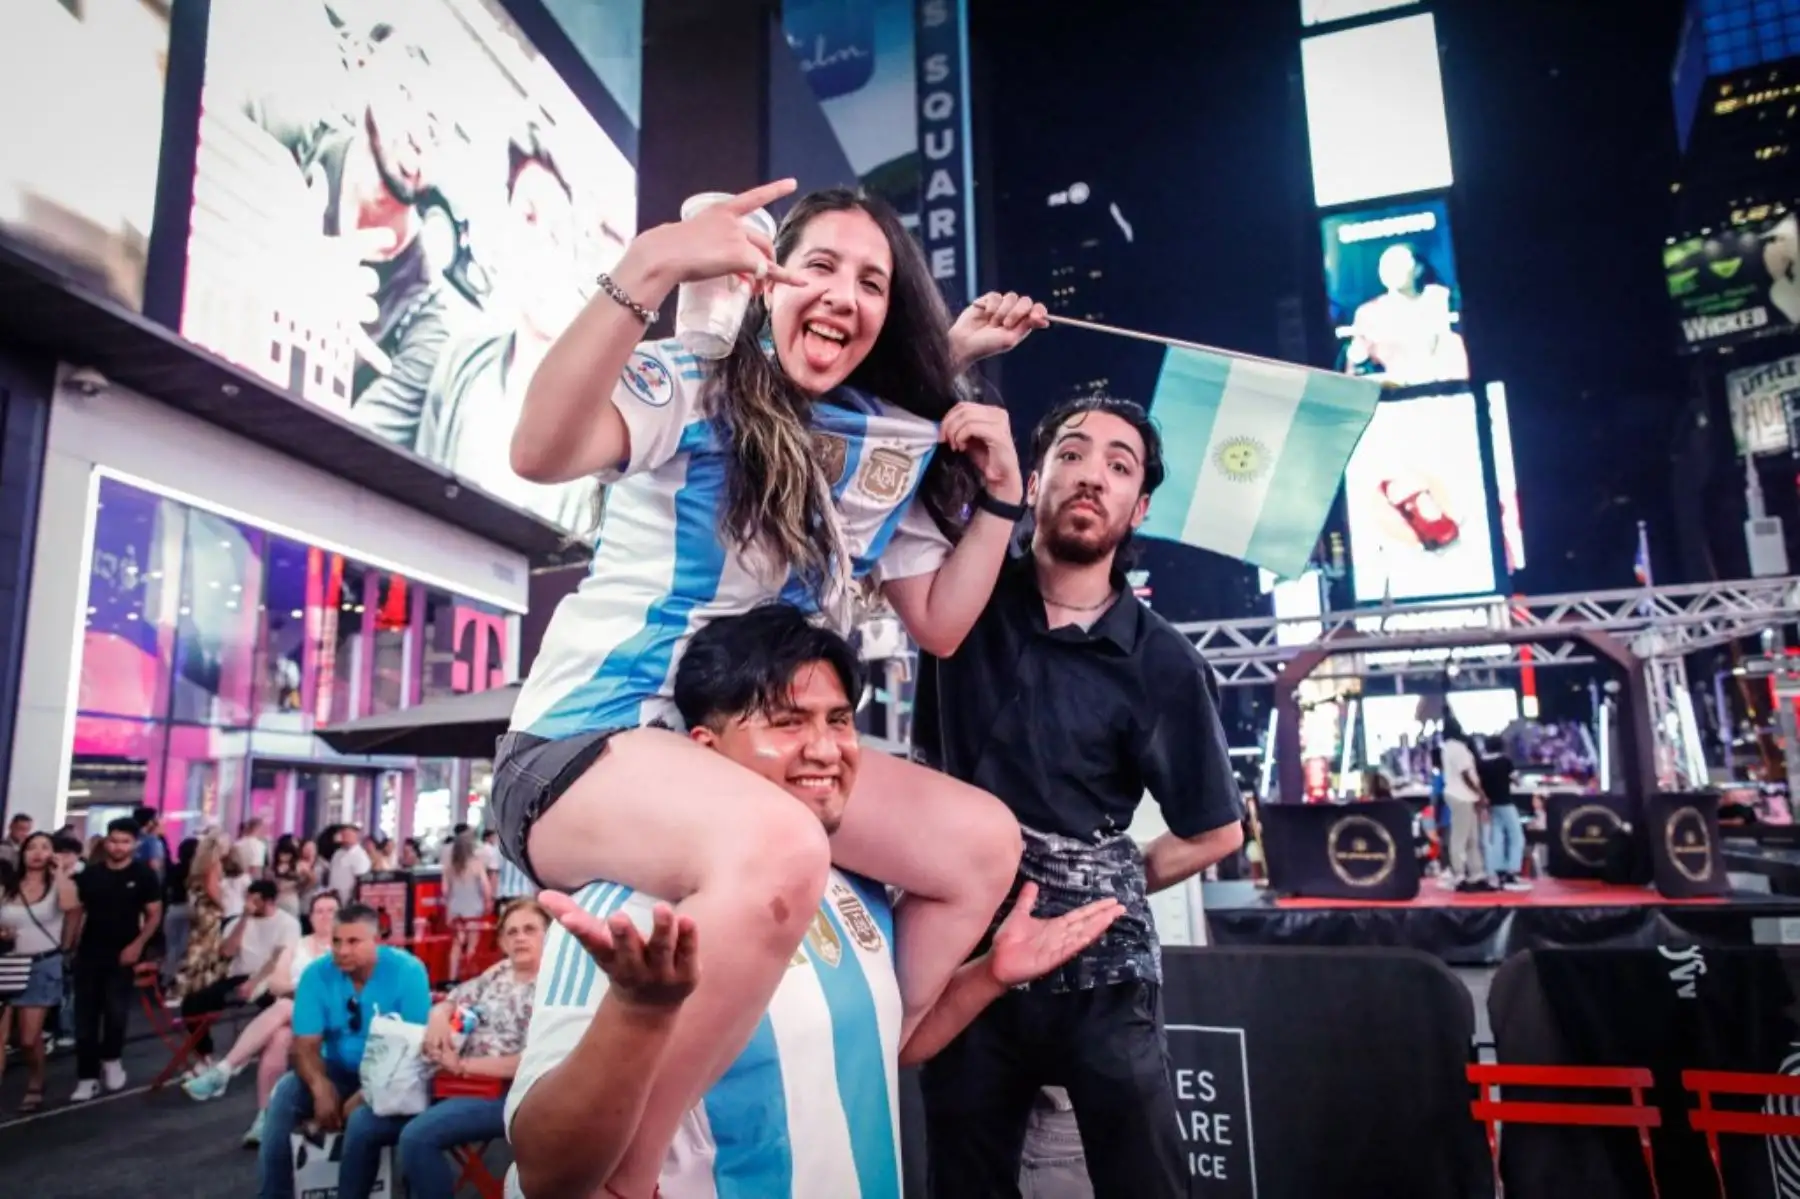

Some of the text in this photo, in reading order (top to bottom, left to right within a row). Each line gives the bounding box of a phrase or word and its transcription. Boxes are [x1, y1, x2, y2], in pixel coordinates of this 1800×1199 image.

[922, 53, 957, 279] SQUARE
[1681, 306, 1769, 343] WICKED
[1741, 359, 1798, 396] LITTLE
